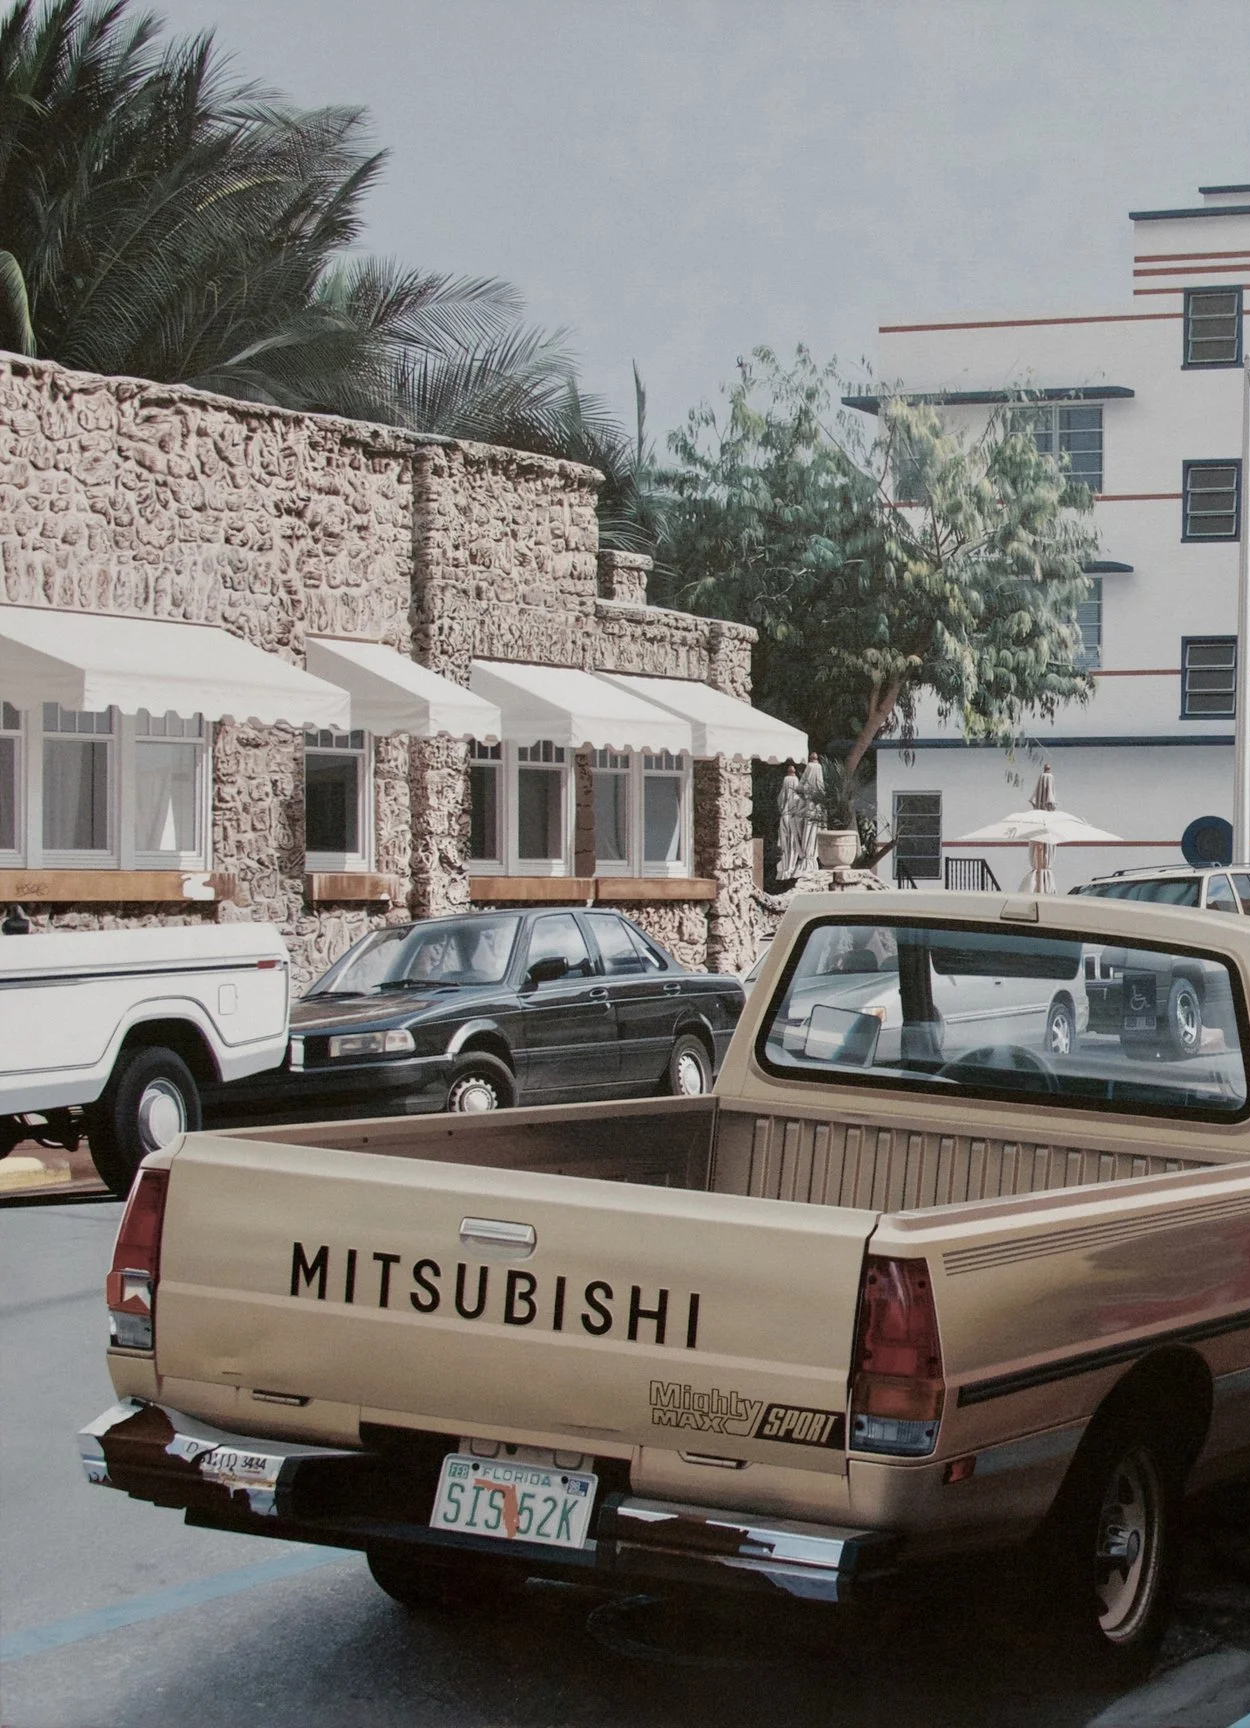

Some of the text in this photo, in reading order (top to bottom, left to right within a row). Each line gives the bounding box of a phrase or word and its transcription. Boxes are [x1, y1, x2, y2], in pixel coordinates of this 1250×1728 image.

[290, 1241, 701, 1349] MITSUBISHI
[649, 1379, 764, 1438] Mighty
[651, 1407, 725, 1435] MAX
[762, 1406, 838, 1444] SPORT
[482, 1466, 552, 1488] FLORIDA
[516, 1491, 579, 1541] 52K
